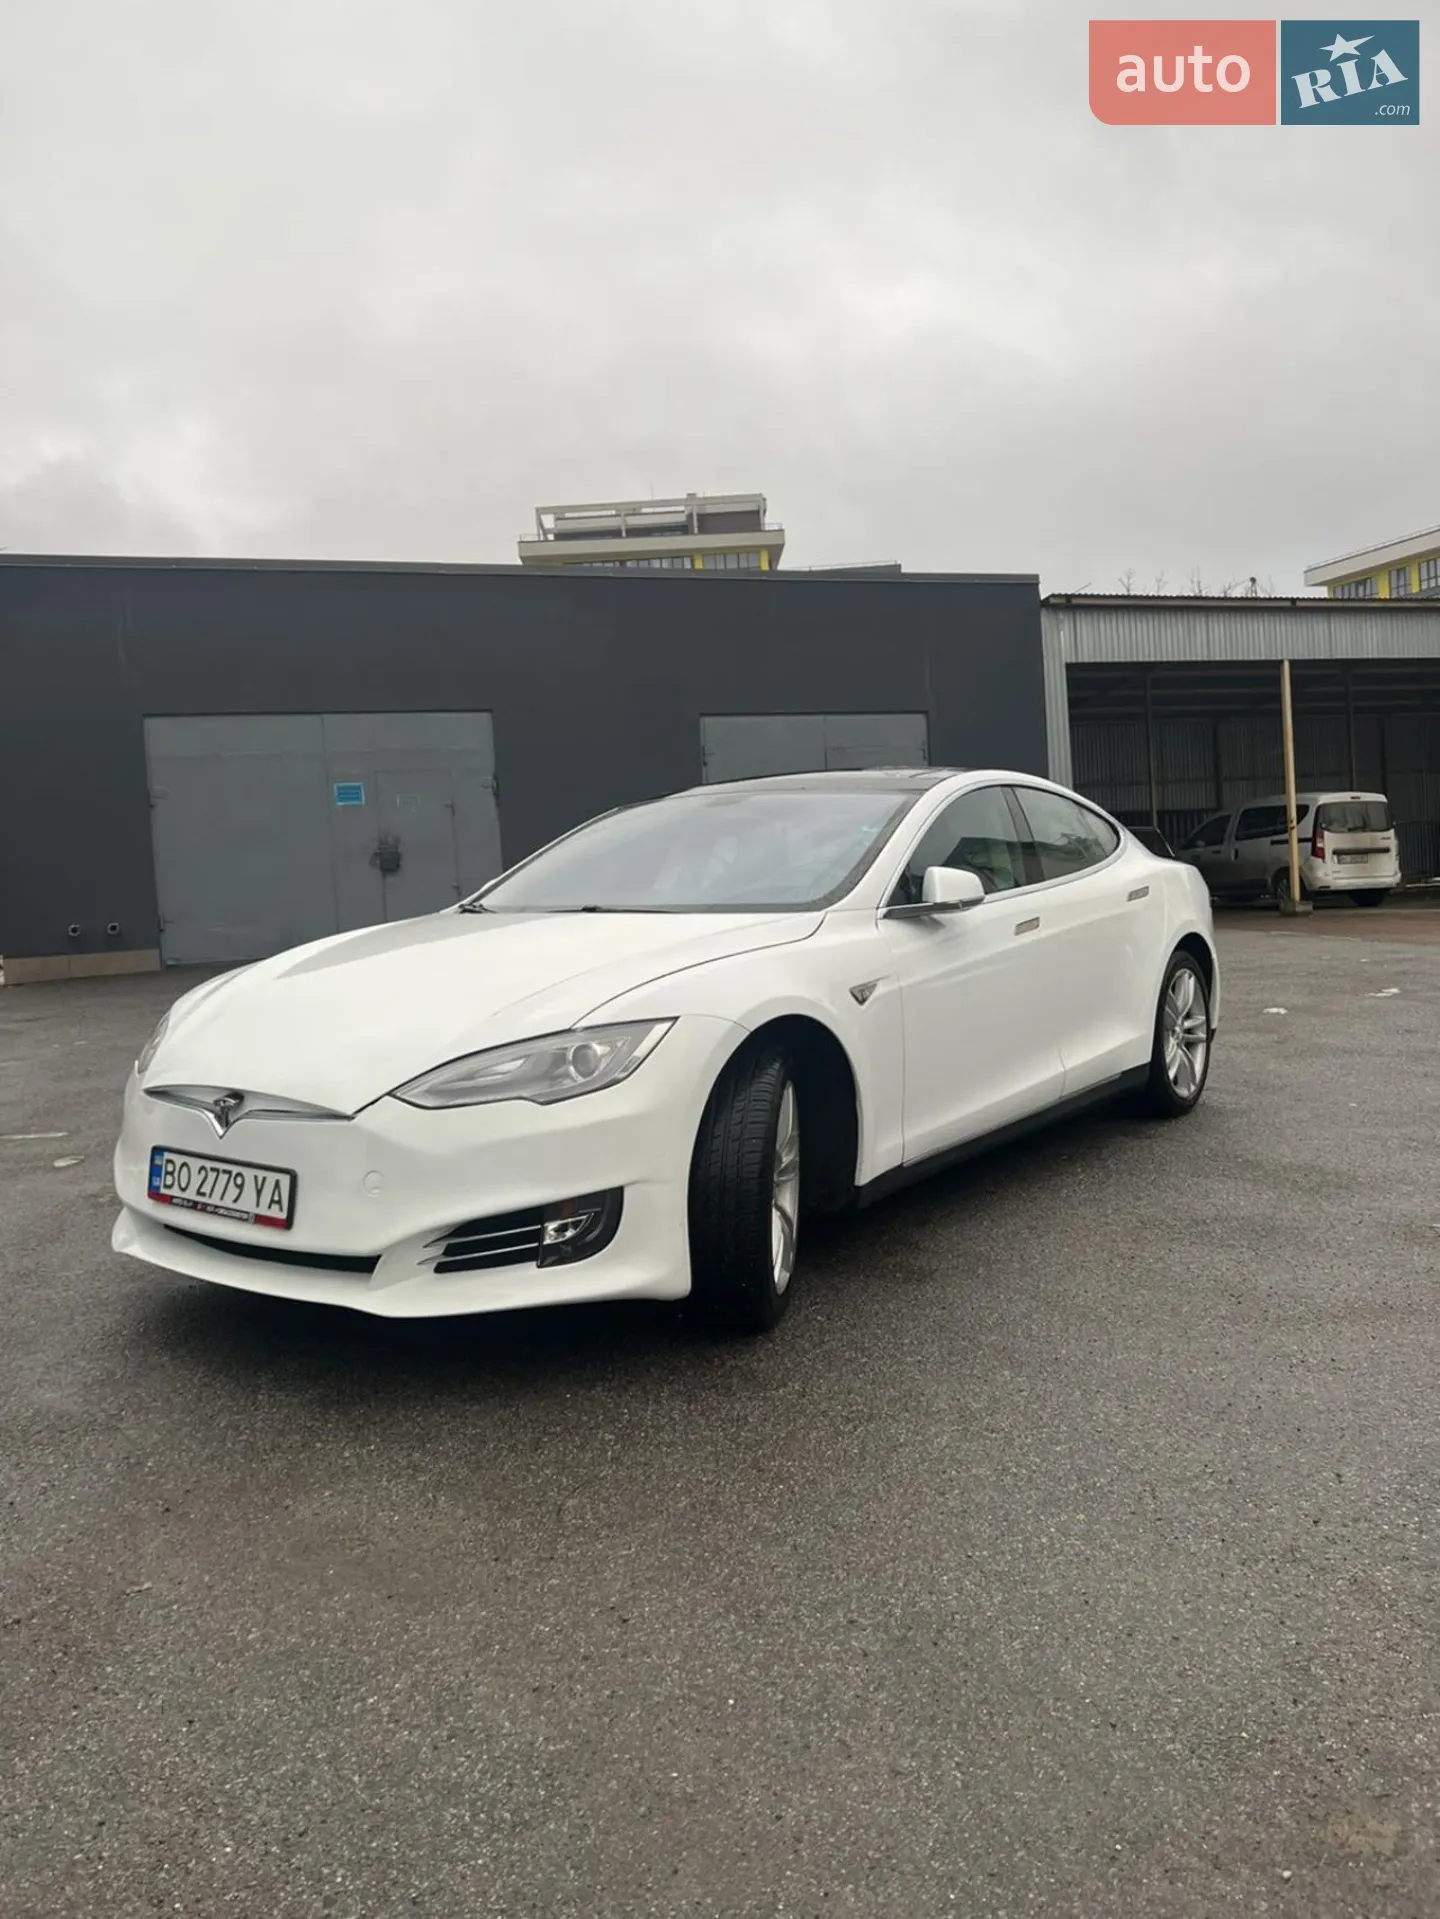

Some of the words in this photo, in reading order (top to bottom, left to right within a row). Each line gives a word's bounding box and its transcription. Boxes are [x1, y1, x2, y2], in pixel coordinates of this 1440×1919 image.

[163, 1158, 191, 1192] BO
[196, 1165, 245, 1204] 2779
[253, 1174, 284, 1213] YA
